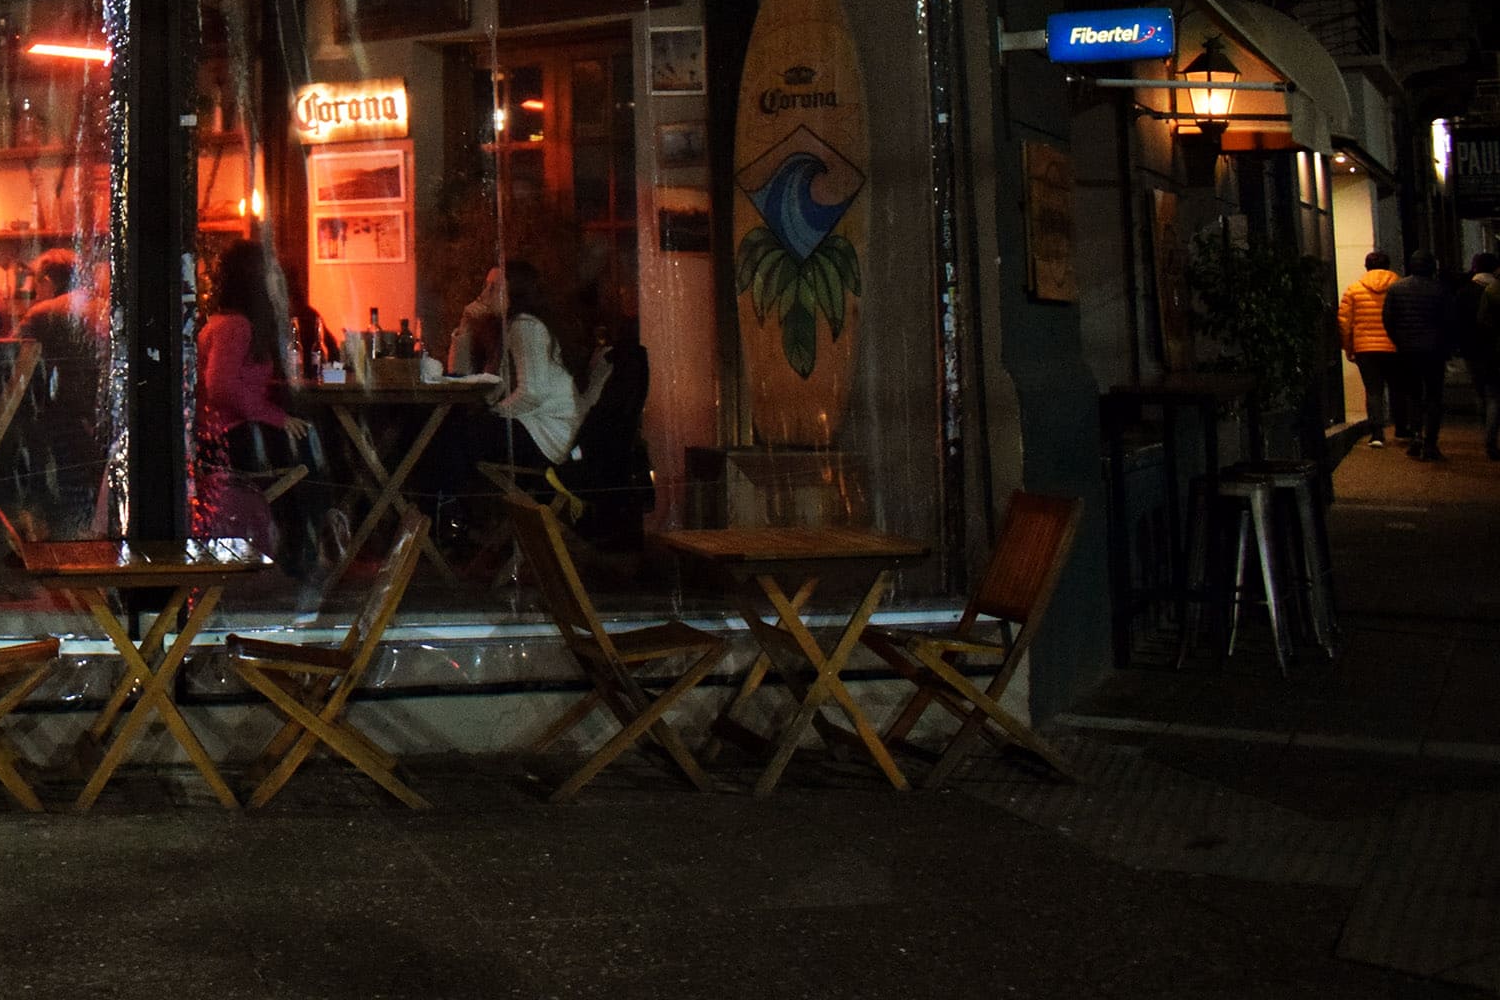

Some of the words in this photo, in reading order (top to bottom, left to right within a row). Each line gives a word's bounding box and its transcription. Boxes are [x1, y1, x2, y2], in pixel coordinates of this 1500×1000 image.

[1070, 24, 1140, 44] Fibertel
[296, 92, 399, 135] Corona
[760, 87, 838, 116] Corona
